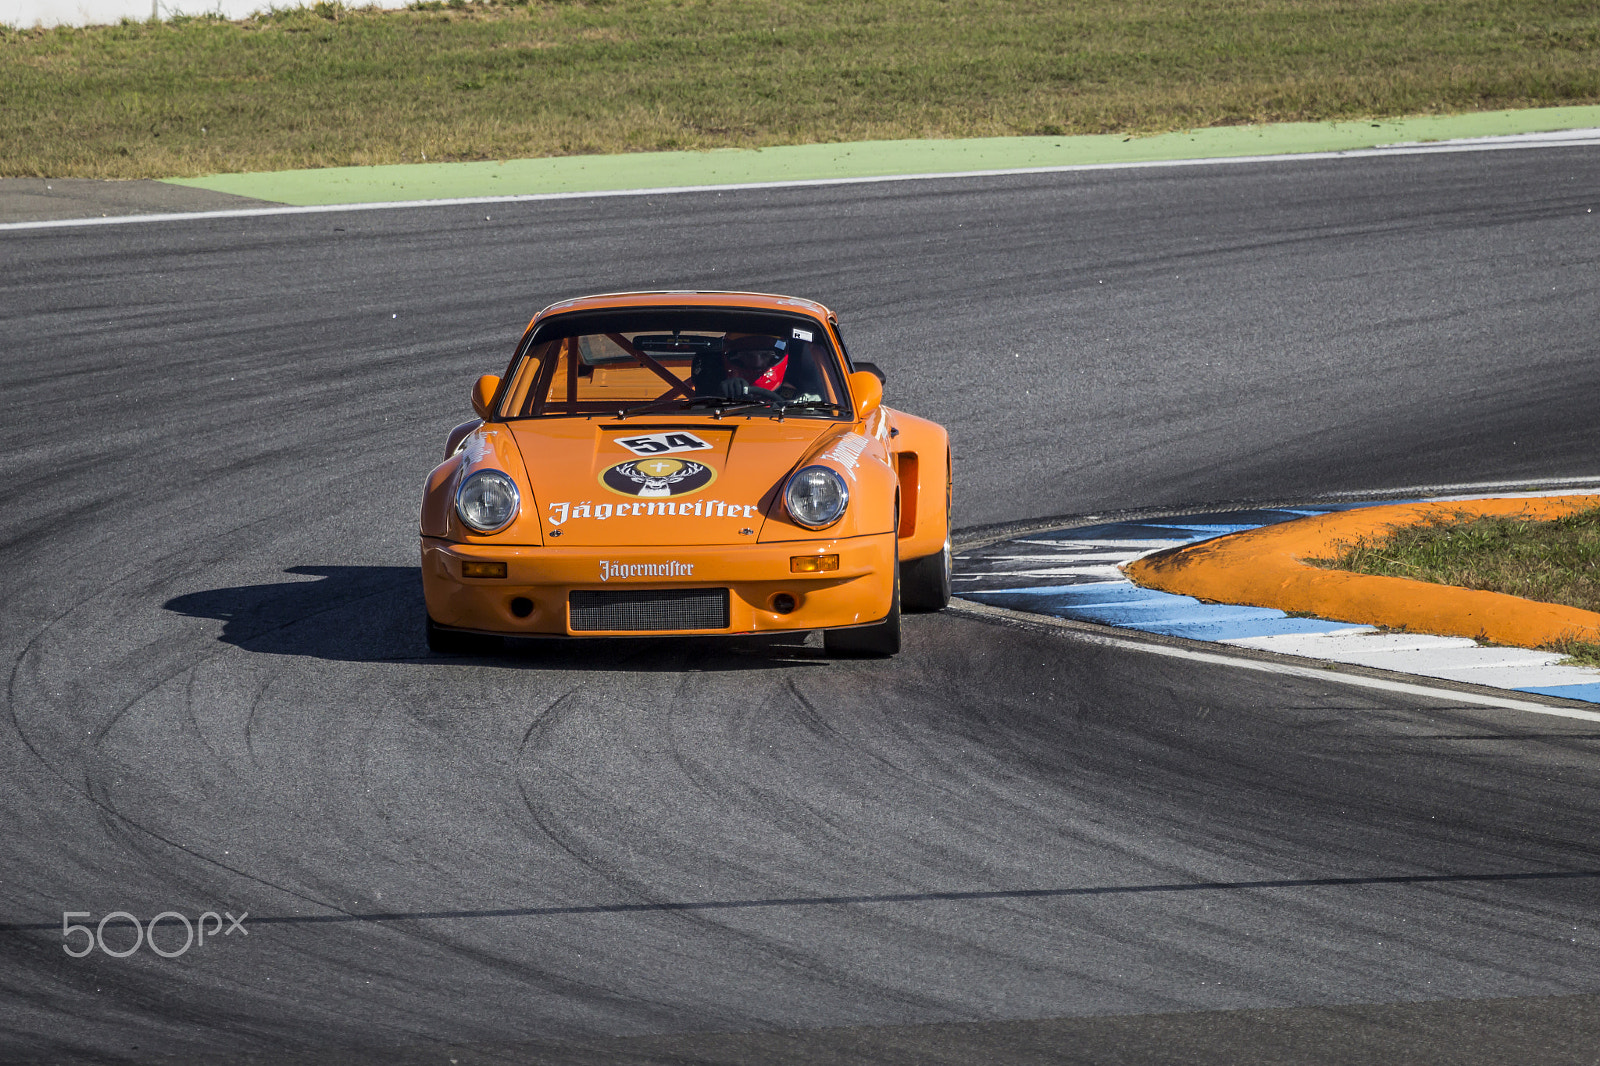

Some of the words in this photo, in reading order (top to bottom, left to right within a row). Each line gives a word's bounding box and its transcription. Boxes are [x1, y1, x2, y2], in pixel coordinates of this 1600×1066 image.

[622, 434, 706, 453] 54
[549, 500, 758, 526] Jägermeister
[599, 560, 694, 582] Jägermeister
